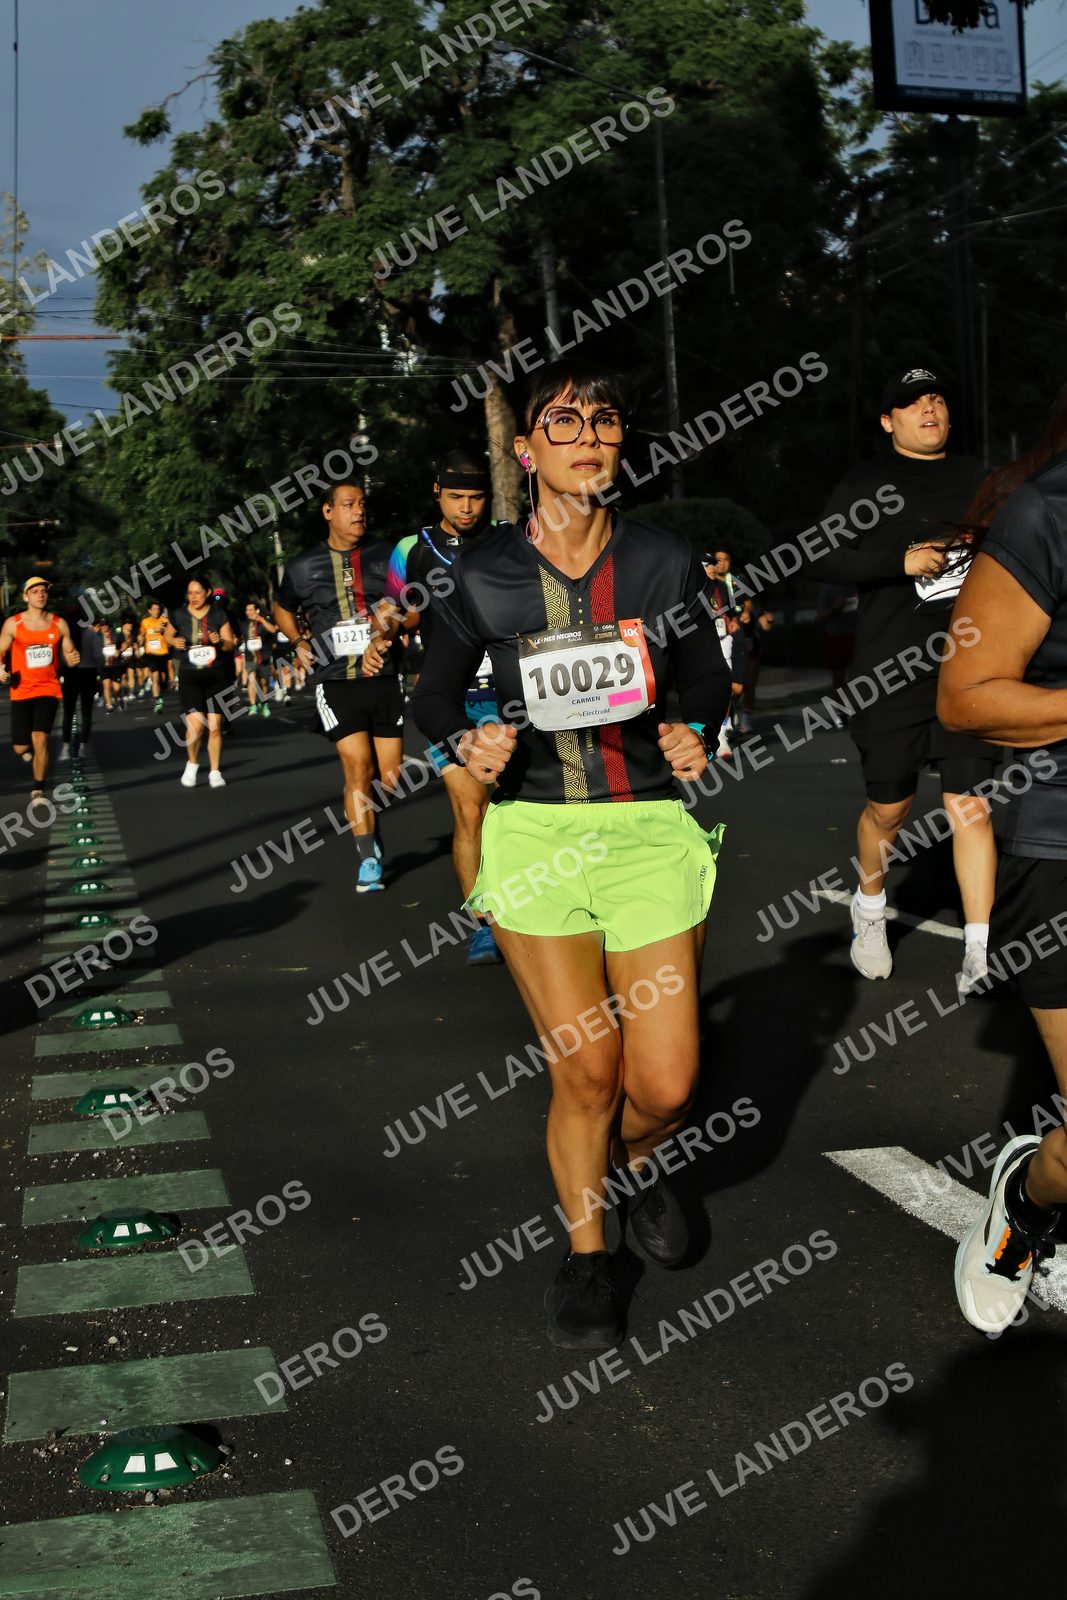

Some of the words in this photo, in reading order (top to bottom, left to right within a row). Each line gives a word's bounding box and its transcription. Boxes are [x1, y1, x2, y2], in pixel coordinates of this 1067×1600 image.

[556, 631, 582, 640] NEGROS
[528, 653, 635, 699] 10029
[571, 696, 601, 705] CARMEN
